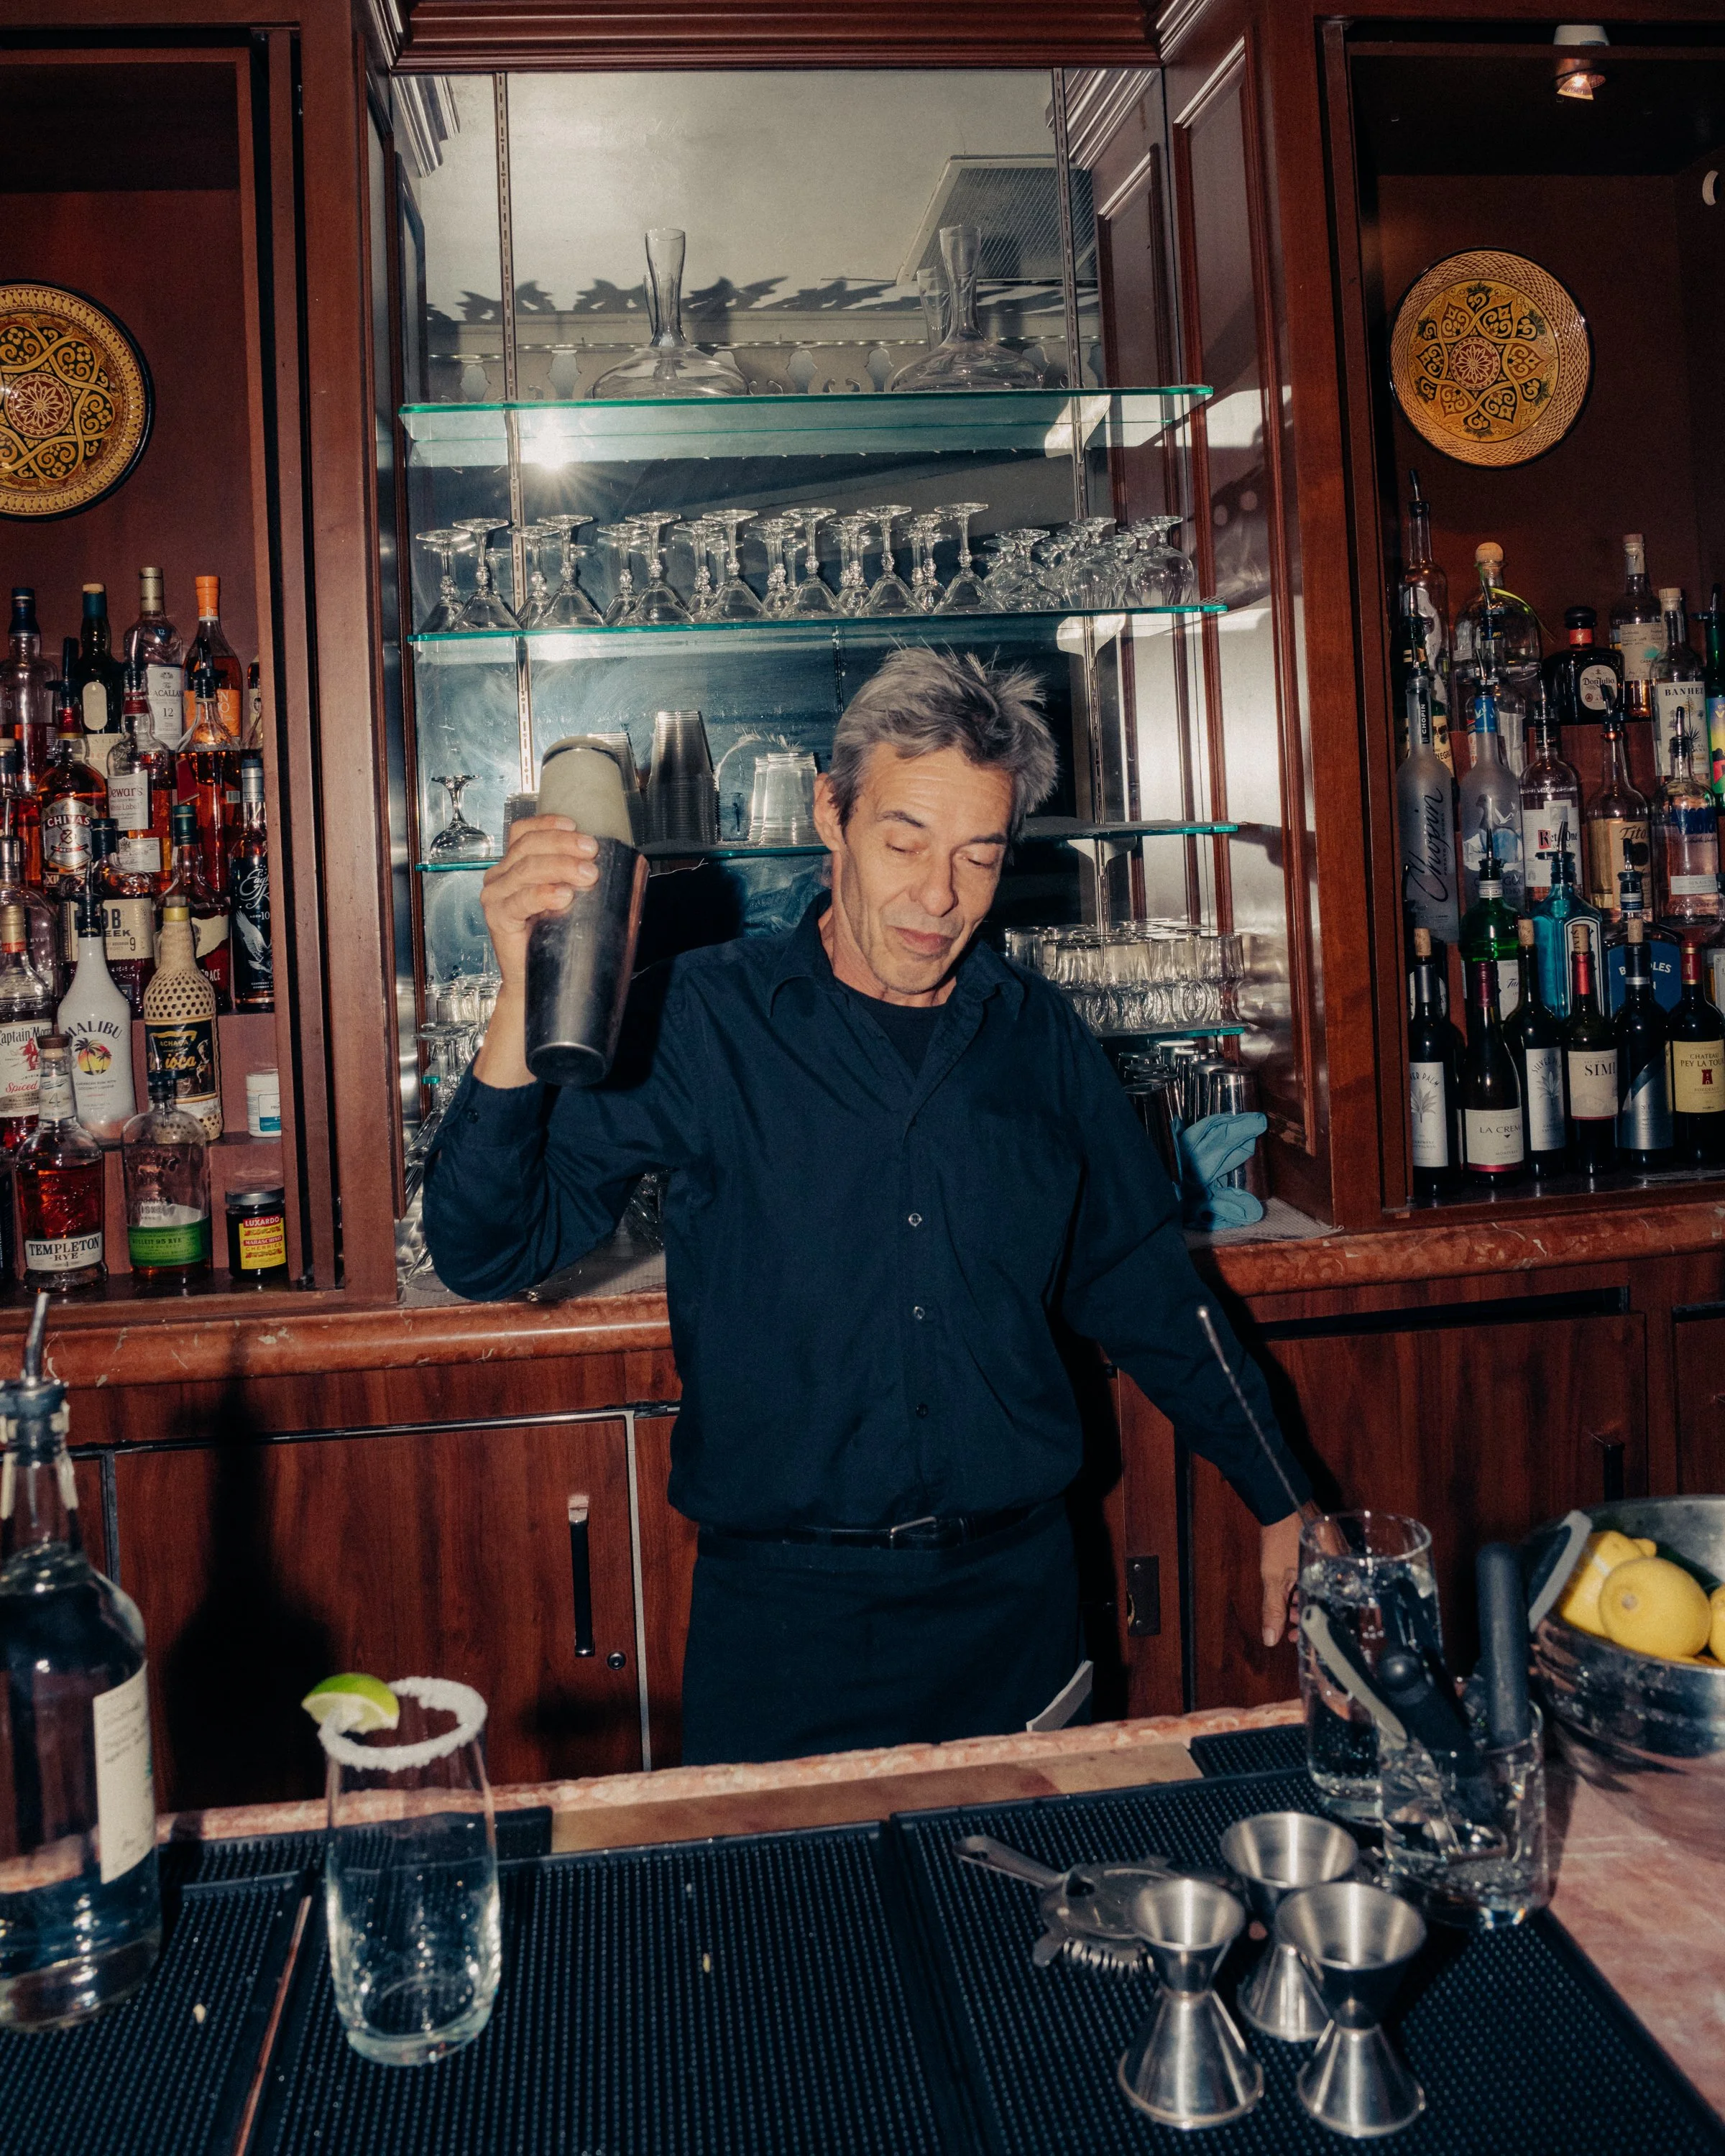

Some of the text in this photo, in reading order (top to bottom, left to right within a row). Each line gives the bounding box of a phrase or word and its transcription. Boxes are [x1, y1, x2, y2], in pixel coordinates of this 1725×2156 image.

[1582, 677, 1598, 686] Don
[162, 707, 174, 717] 12
[47, 816, 91, 826] CHIVAS
[261, 911, 270, 920] 10
[129, 936, 136, 952] 9
[65, 1021, 122, 1040] MALIBU
[1584, 1062, 1616, 1076] SIMI
[5, 1080, 38, 1093] Spiced
[49, 1092, 61, 1107] 4
[1496, 1125, 1521, 1133] CREM
[245, 1216, 280, 1227] LUXARDO
[29, 1235, 99, 1256] TEMPLETON
[245, 1236, 282, 1245] MARASCHINO
[245, 1242, 282, 1251] CHERRIES
